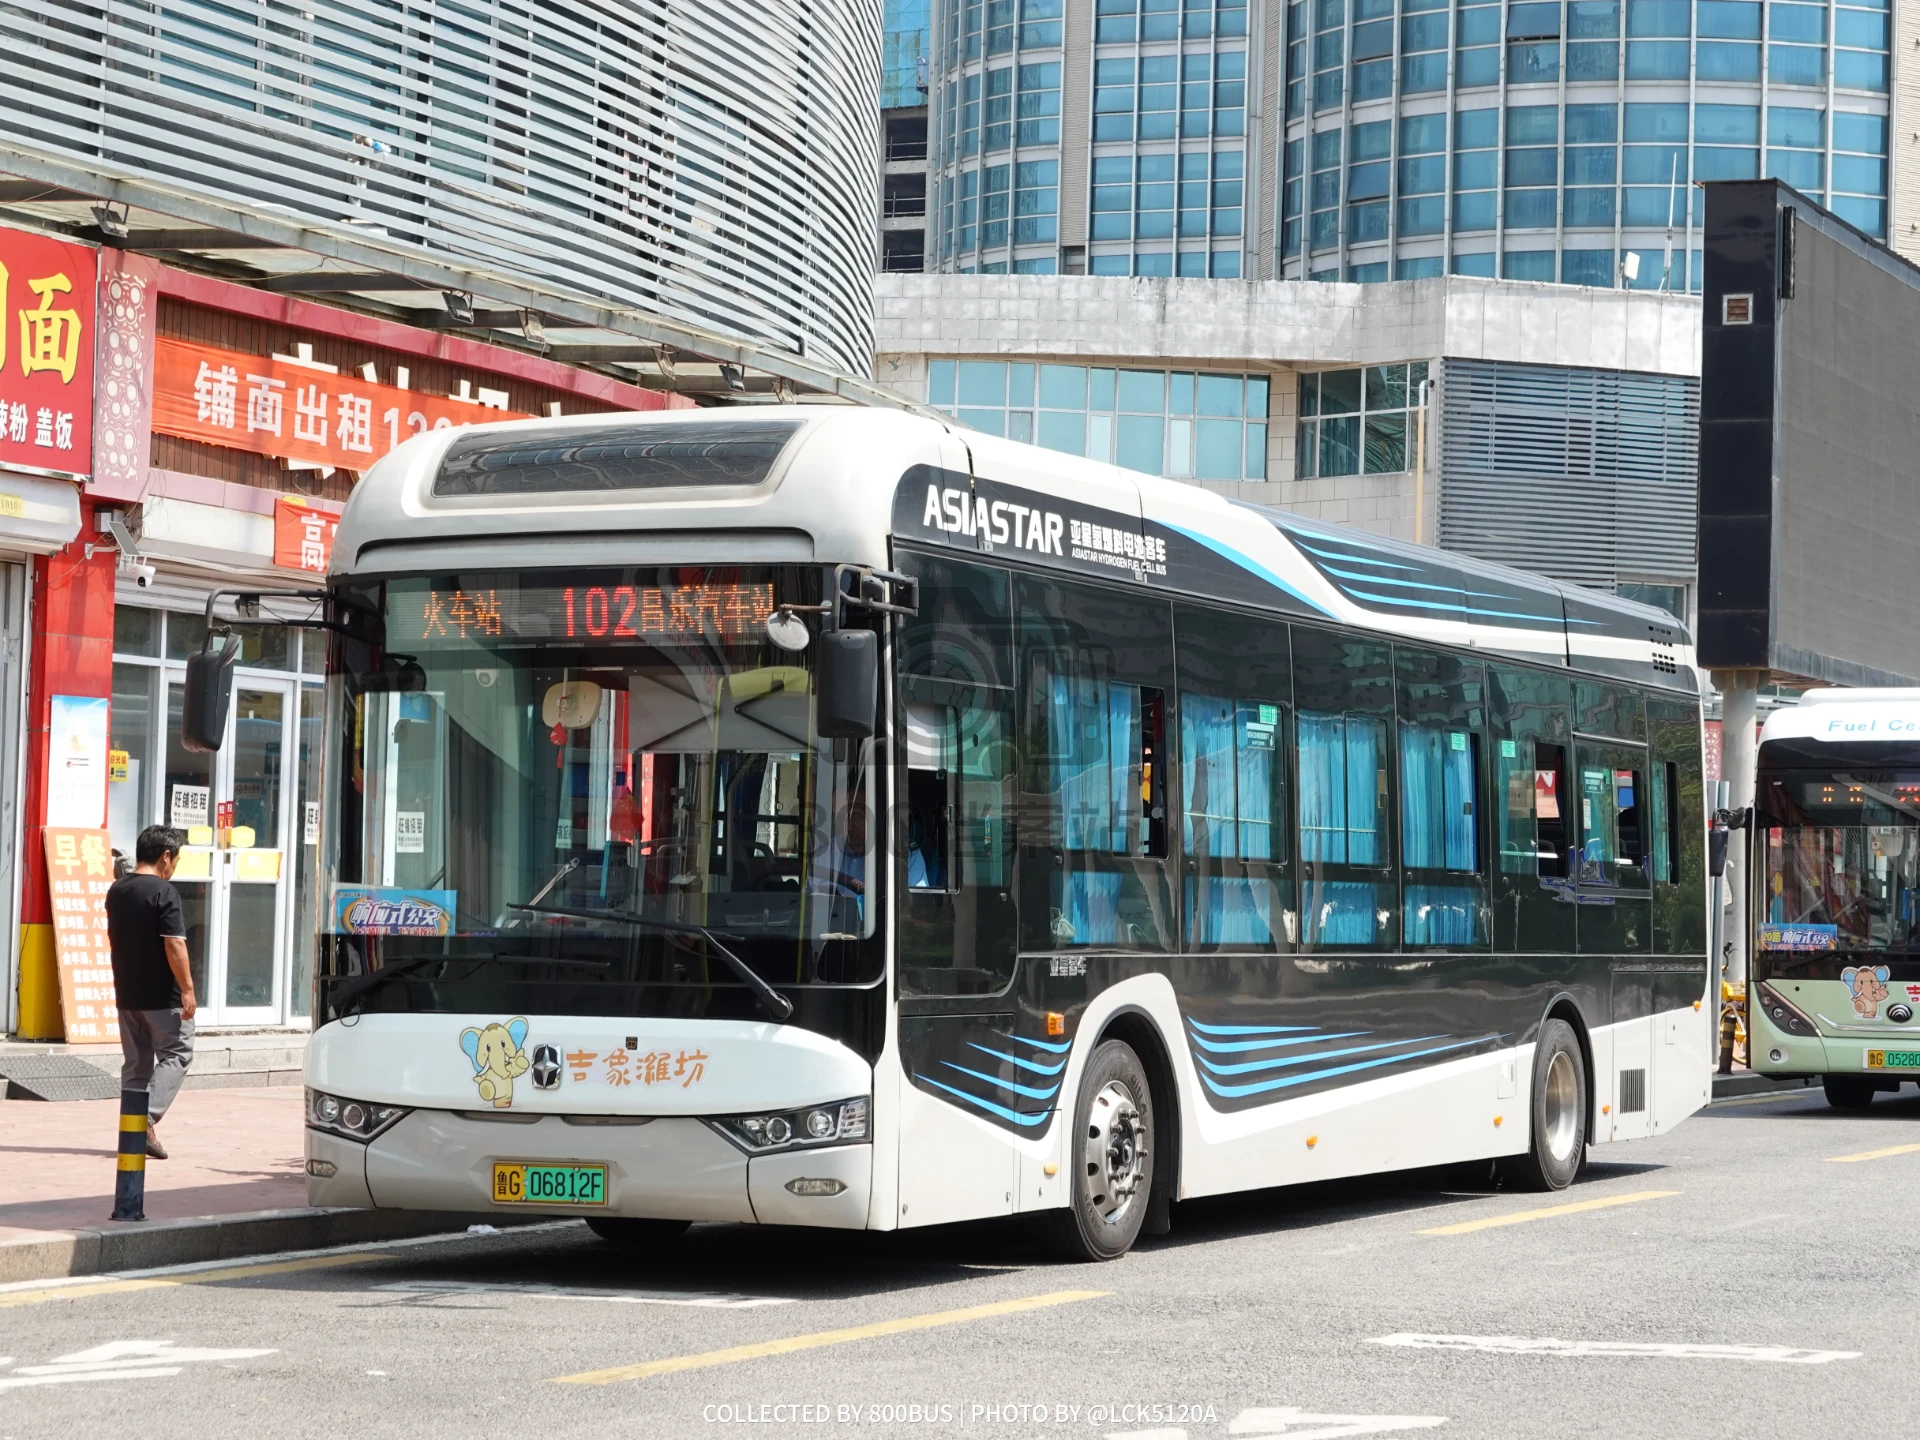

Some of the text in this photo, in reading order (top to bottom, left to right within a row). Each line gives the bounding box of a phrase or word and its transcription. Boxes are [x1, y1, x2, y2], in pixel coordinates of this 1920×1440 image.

[0, 260, 82, 385] 面
[35, 407, 74, 450] 盖饭
[193, 361, 372, 454] 铺面出租
[923, 484, 1064, 556] ASIASTAR
[1070, 519, 1167, 563] 亚星氢燃料电池客车
[300, 513, 336, 572] 高
[1072, 547, 1098, 562] ASIASTAR
[1098, 552, 1128, 569] HYDROGEN
[1128, 559, 1141, 571] FUEL
[1155, 563, 1167, 576] BUS
[422, 583, 774, 639] 火车站 102 昌乐汽车站
[1828, 720, 1920, 732] Fuel Ce
[175, 791, 207, 810] 旺铺招租
[55, 834, 106, 877] 早餐
[351, 901, 441, 926] 响应式公交
